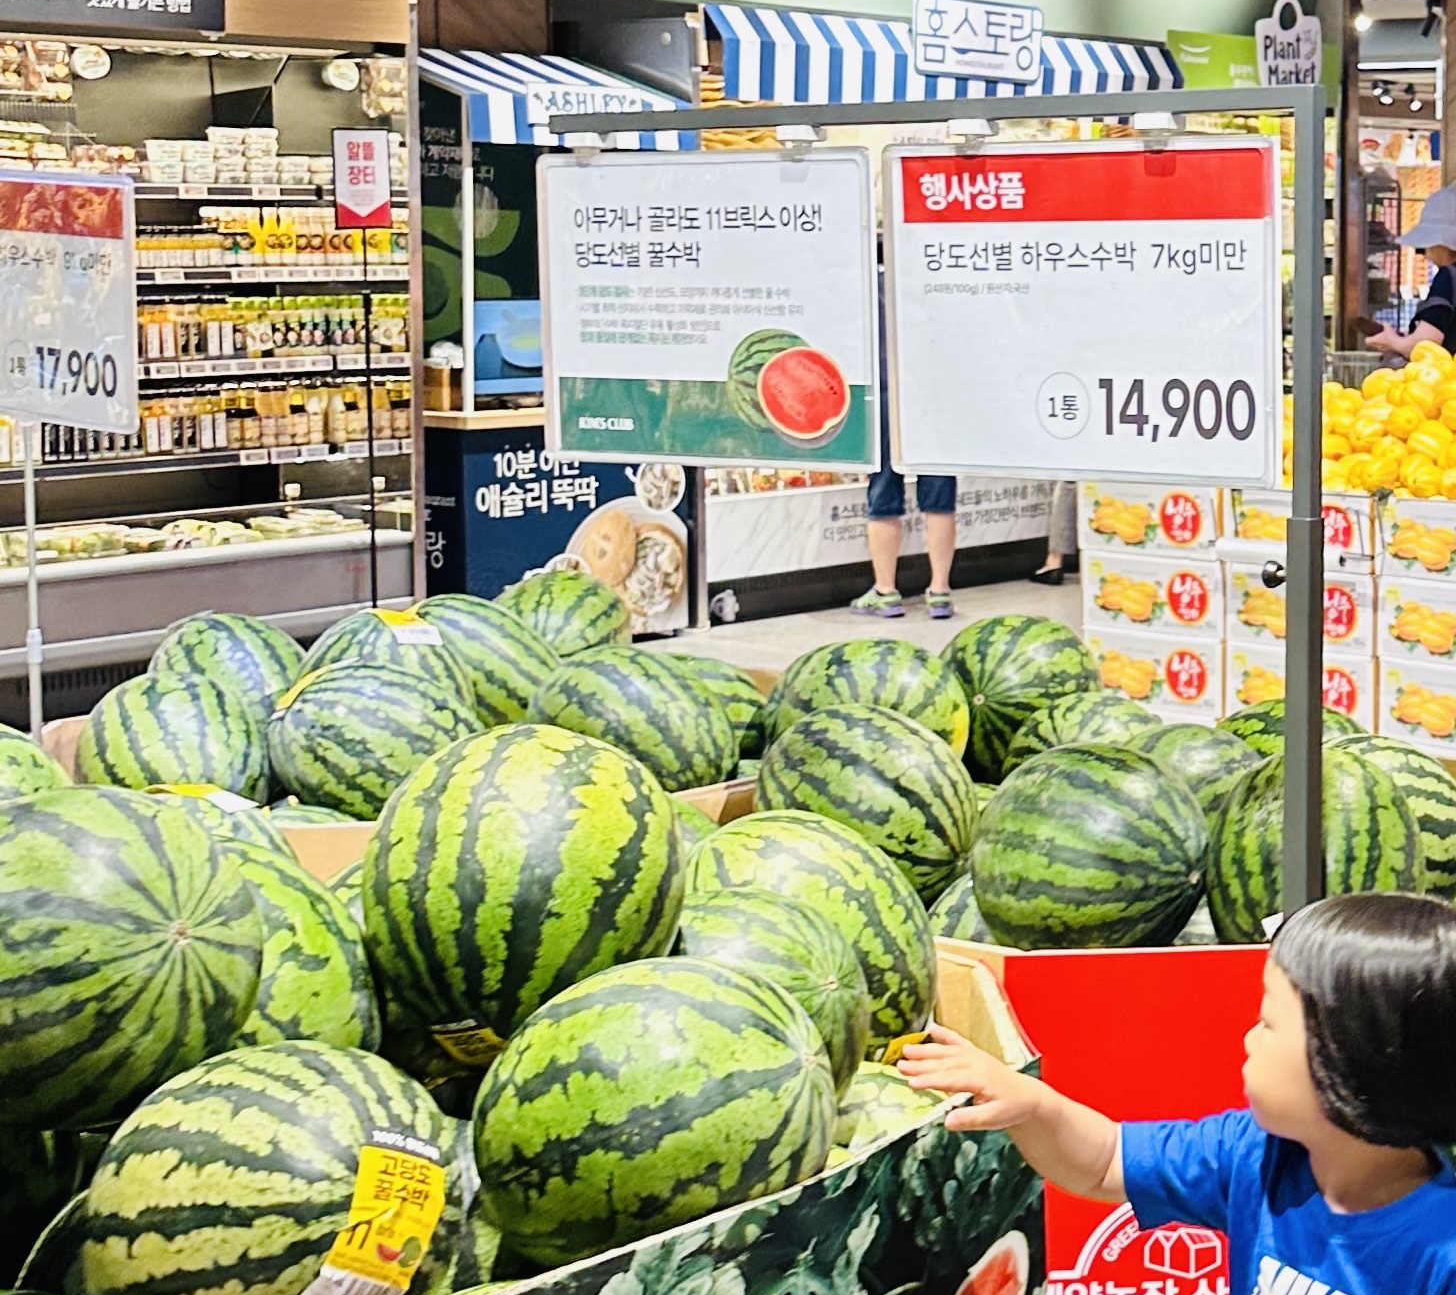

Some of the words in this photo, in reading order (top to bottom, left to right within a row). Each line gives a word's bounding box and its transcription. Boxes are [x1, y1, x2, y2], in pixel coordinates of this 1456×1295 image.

[1263, 34, 1301, 61] Plant
[1268, 62, 1316, 85] Market
[348, 165, 376, 186] 장터
[919, 171, 1026, 211] 행사상품
[573, 205, 643, 233] 아무거나
[647, 205, 702, 233] 골라도
[704, 205, 777, 232] 11브릭스
[778, 204, 823, 233] 이상!
[574, 241, 642, 269] 당도선별
[646, 240, 702, 269] 꿀수박
[923, 241, 1013, 273] 당도선별
[1020, 240, 1138, 273] 하우스수박
[1150, 239, 1248, 276] 7kg미만
[35, 345, 118, 398] 17,900
[1047, 394, 1080, 422] 1통
[1097, 377, 1257, 443] 14,900
[492, 449, 538, 480] 10분
[475, 480, 549, 519] 애슐리
[551, 475, 600, 512] 뚝딱
[379, 1155, 433, 1187] 고당도
[373, 1178, 430, 1212] 꿀수박
